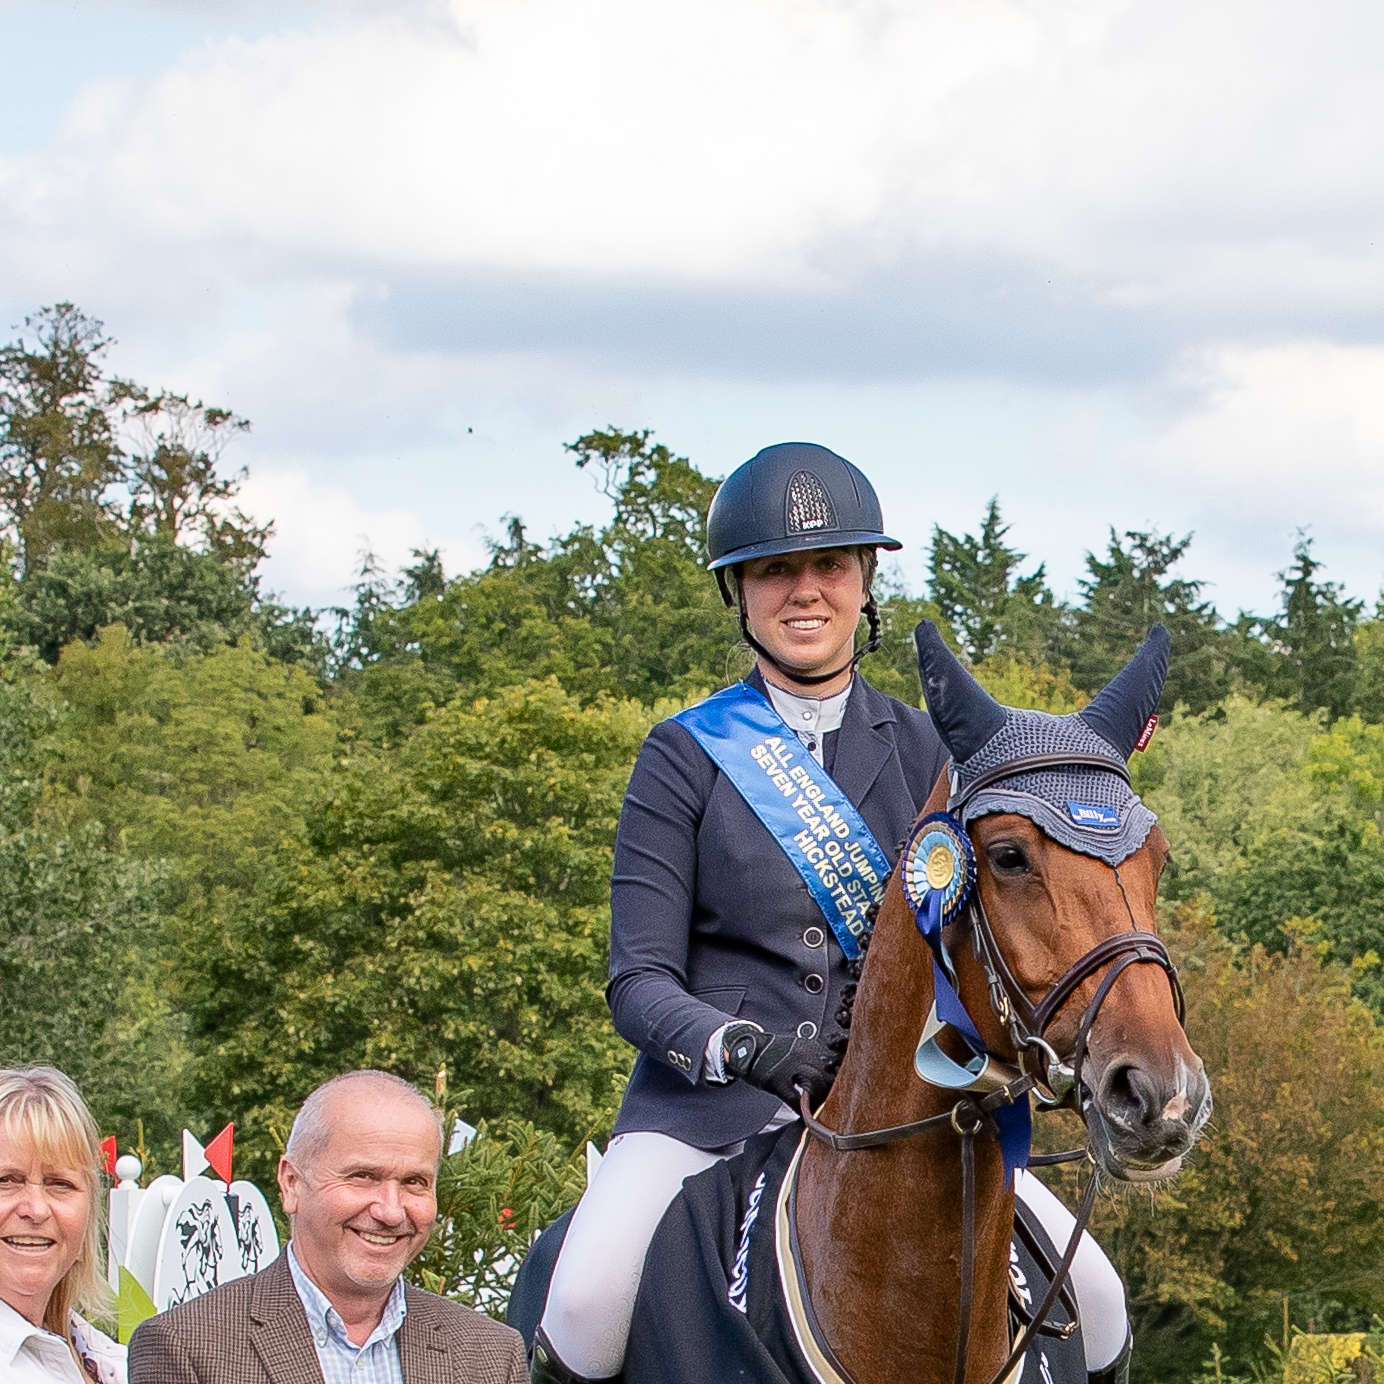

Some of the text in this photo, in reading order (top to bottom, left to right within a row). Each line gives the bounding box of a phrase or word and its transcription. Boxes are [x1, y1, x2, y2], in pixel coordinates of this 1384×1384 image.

[750, 744, 872, 920] SEVEN YEAR OLD STA
[765, 736, 886, 905] ALL ENGLAND JUMPIN
[793, 829, 866, 937] HICKSTEAD
